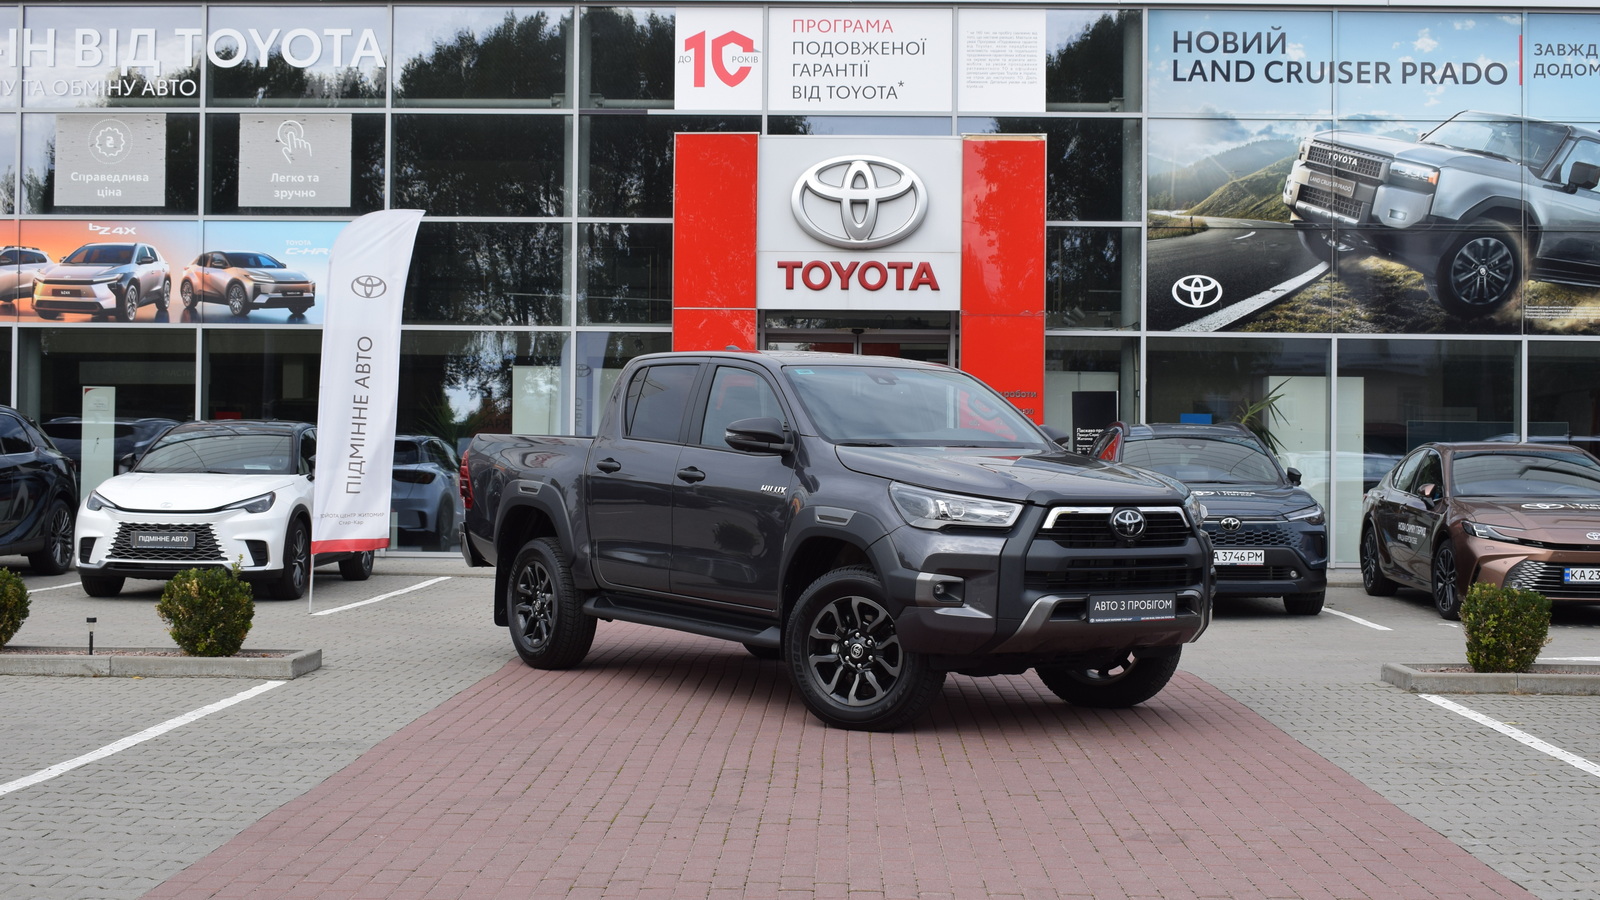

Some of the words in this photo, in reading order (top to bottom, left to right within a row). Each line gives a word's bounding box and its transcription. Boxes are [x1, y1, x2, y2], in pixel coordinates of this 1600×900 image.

[792, 19, 894, 34] ПРОГРАМА
[1173, 26, 1286, 55] НОВИЙ
[0, 28, 55, 67] ІН
[75, 28, 161, 76] ВІД
[175, 28, 386, 68] TOYOTA
[792, 39, 926, 58] ПОДОВЖЕНОЇ
[678, 56, 692, 64] ДО
[684, 30, 754, 88] 10
[731, 56, 759, 64] РОКІВ
[792, 61, 870, 78] ГАРАНТІЇ
[1173, 60, 1256, 83] LAND
[1264, 60, 1392, 85] CRUISER
[1401, 62, 1508, 86] PRADO
[0, 80, 17, 96] У
[22, 79, 46, 96] ТА
[52, 79, 136, 97] ОБМІНУ
[141, 79, 197, 97] АВТО
[792, 86, 822, 102] ВІД
[1328, 152, 1358, 166] TOYOTA
[71, 172, 150, 184] Справедлива
[270, 173, 304, 184] Легко
[306, 175, 320, 184] та
[97, 186, 122, 199] ціна
[273, 188, 317, 200] зручно
[777, 260, 941, 291] TOYOTA
[354, 336, 373, 389] АВТО
[346, 394, 369, 494] ПІДМІННЕ
[760, 484, 788, 496] HILUX
[1214, 551, 1220, 561] A
[1221, 551, 1246, 561] 3746
[1247, 551, 1263, 561] PM
[1570, 569, 1587, 580] KA
[1094, 600, 1118, 611] АВТО
[1120, 601, 1126, 610] З
[1127, 599, 1173, 610] ПРОБІГОМ
